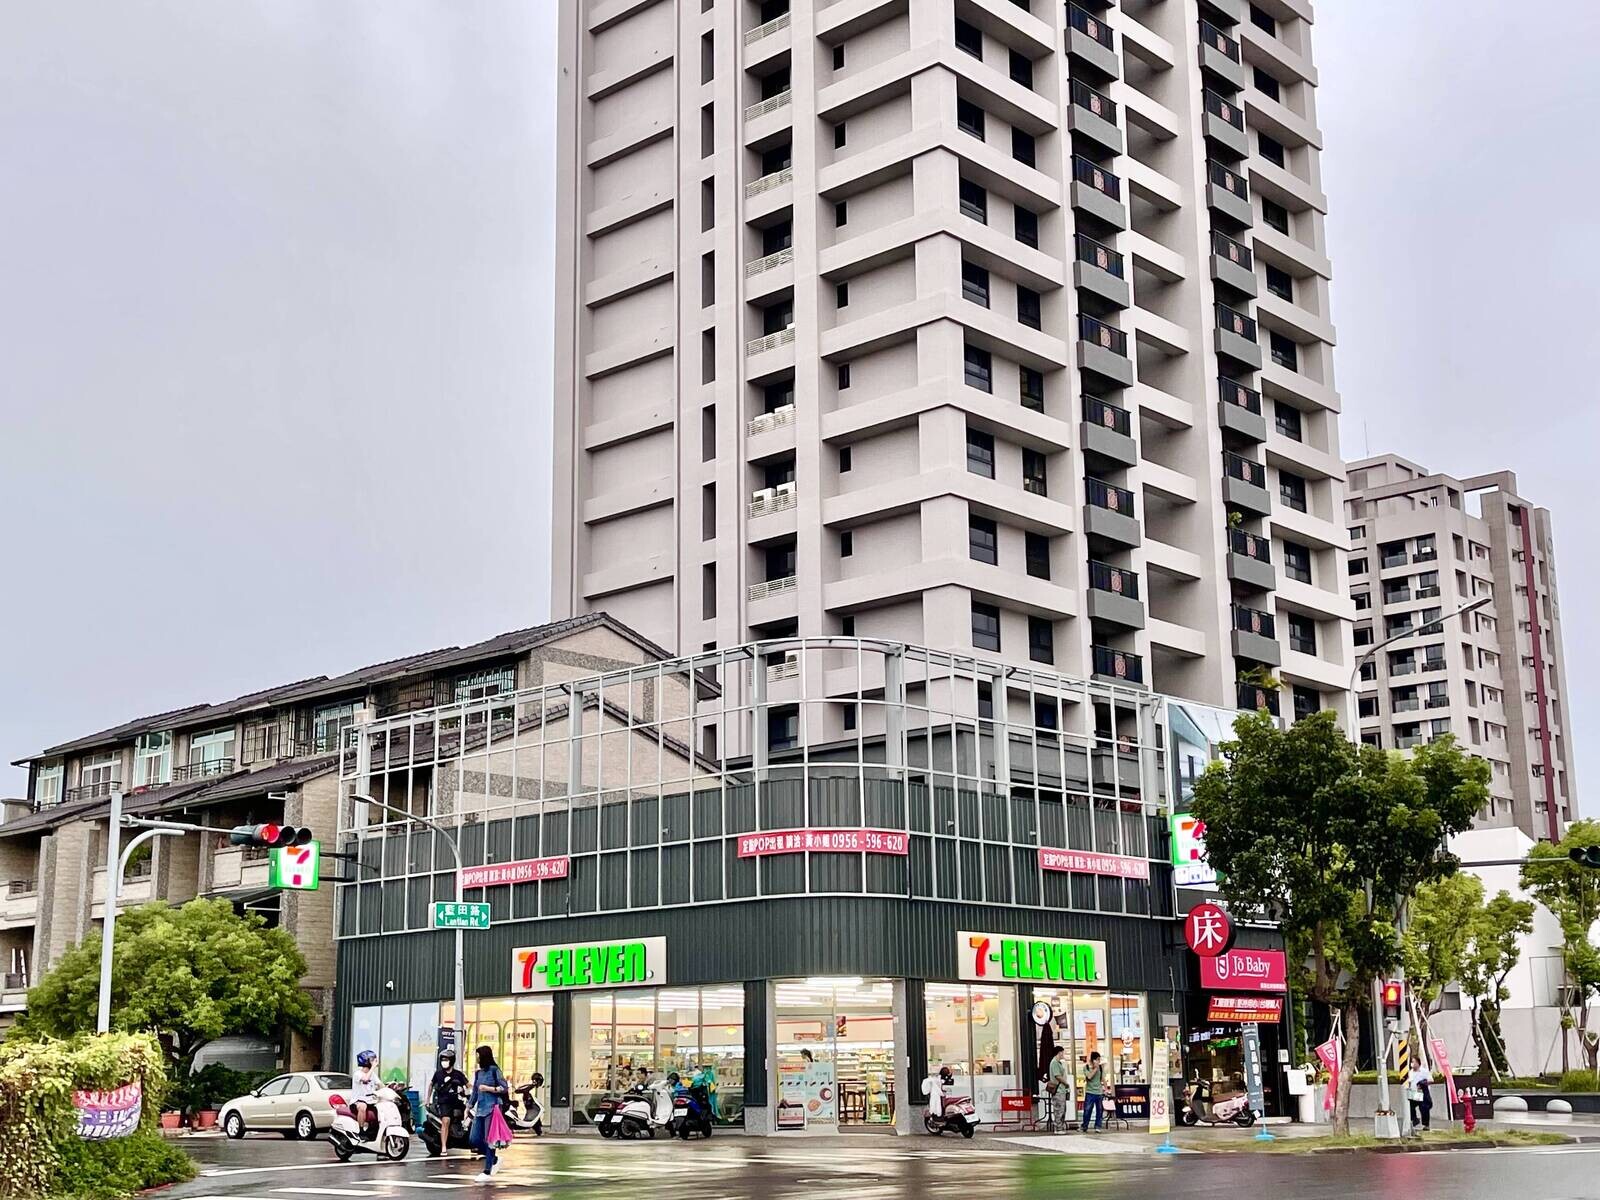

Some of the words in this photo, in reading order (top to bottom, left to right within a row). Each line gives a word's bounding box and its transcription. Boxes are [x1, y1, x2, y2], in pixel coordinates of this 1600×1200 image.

[444, 904, 480, 916] 藍田路
[445, 916, 469, 926] Lantian
[1193, 911, 1223, 949] 床
[518, 943, 647, 989] 7-ELEVEN
[969, 936, 1096, 981] 7-ELEVEN
[1246, 956, 1270, 978] Baby
